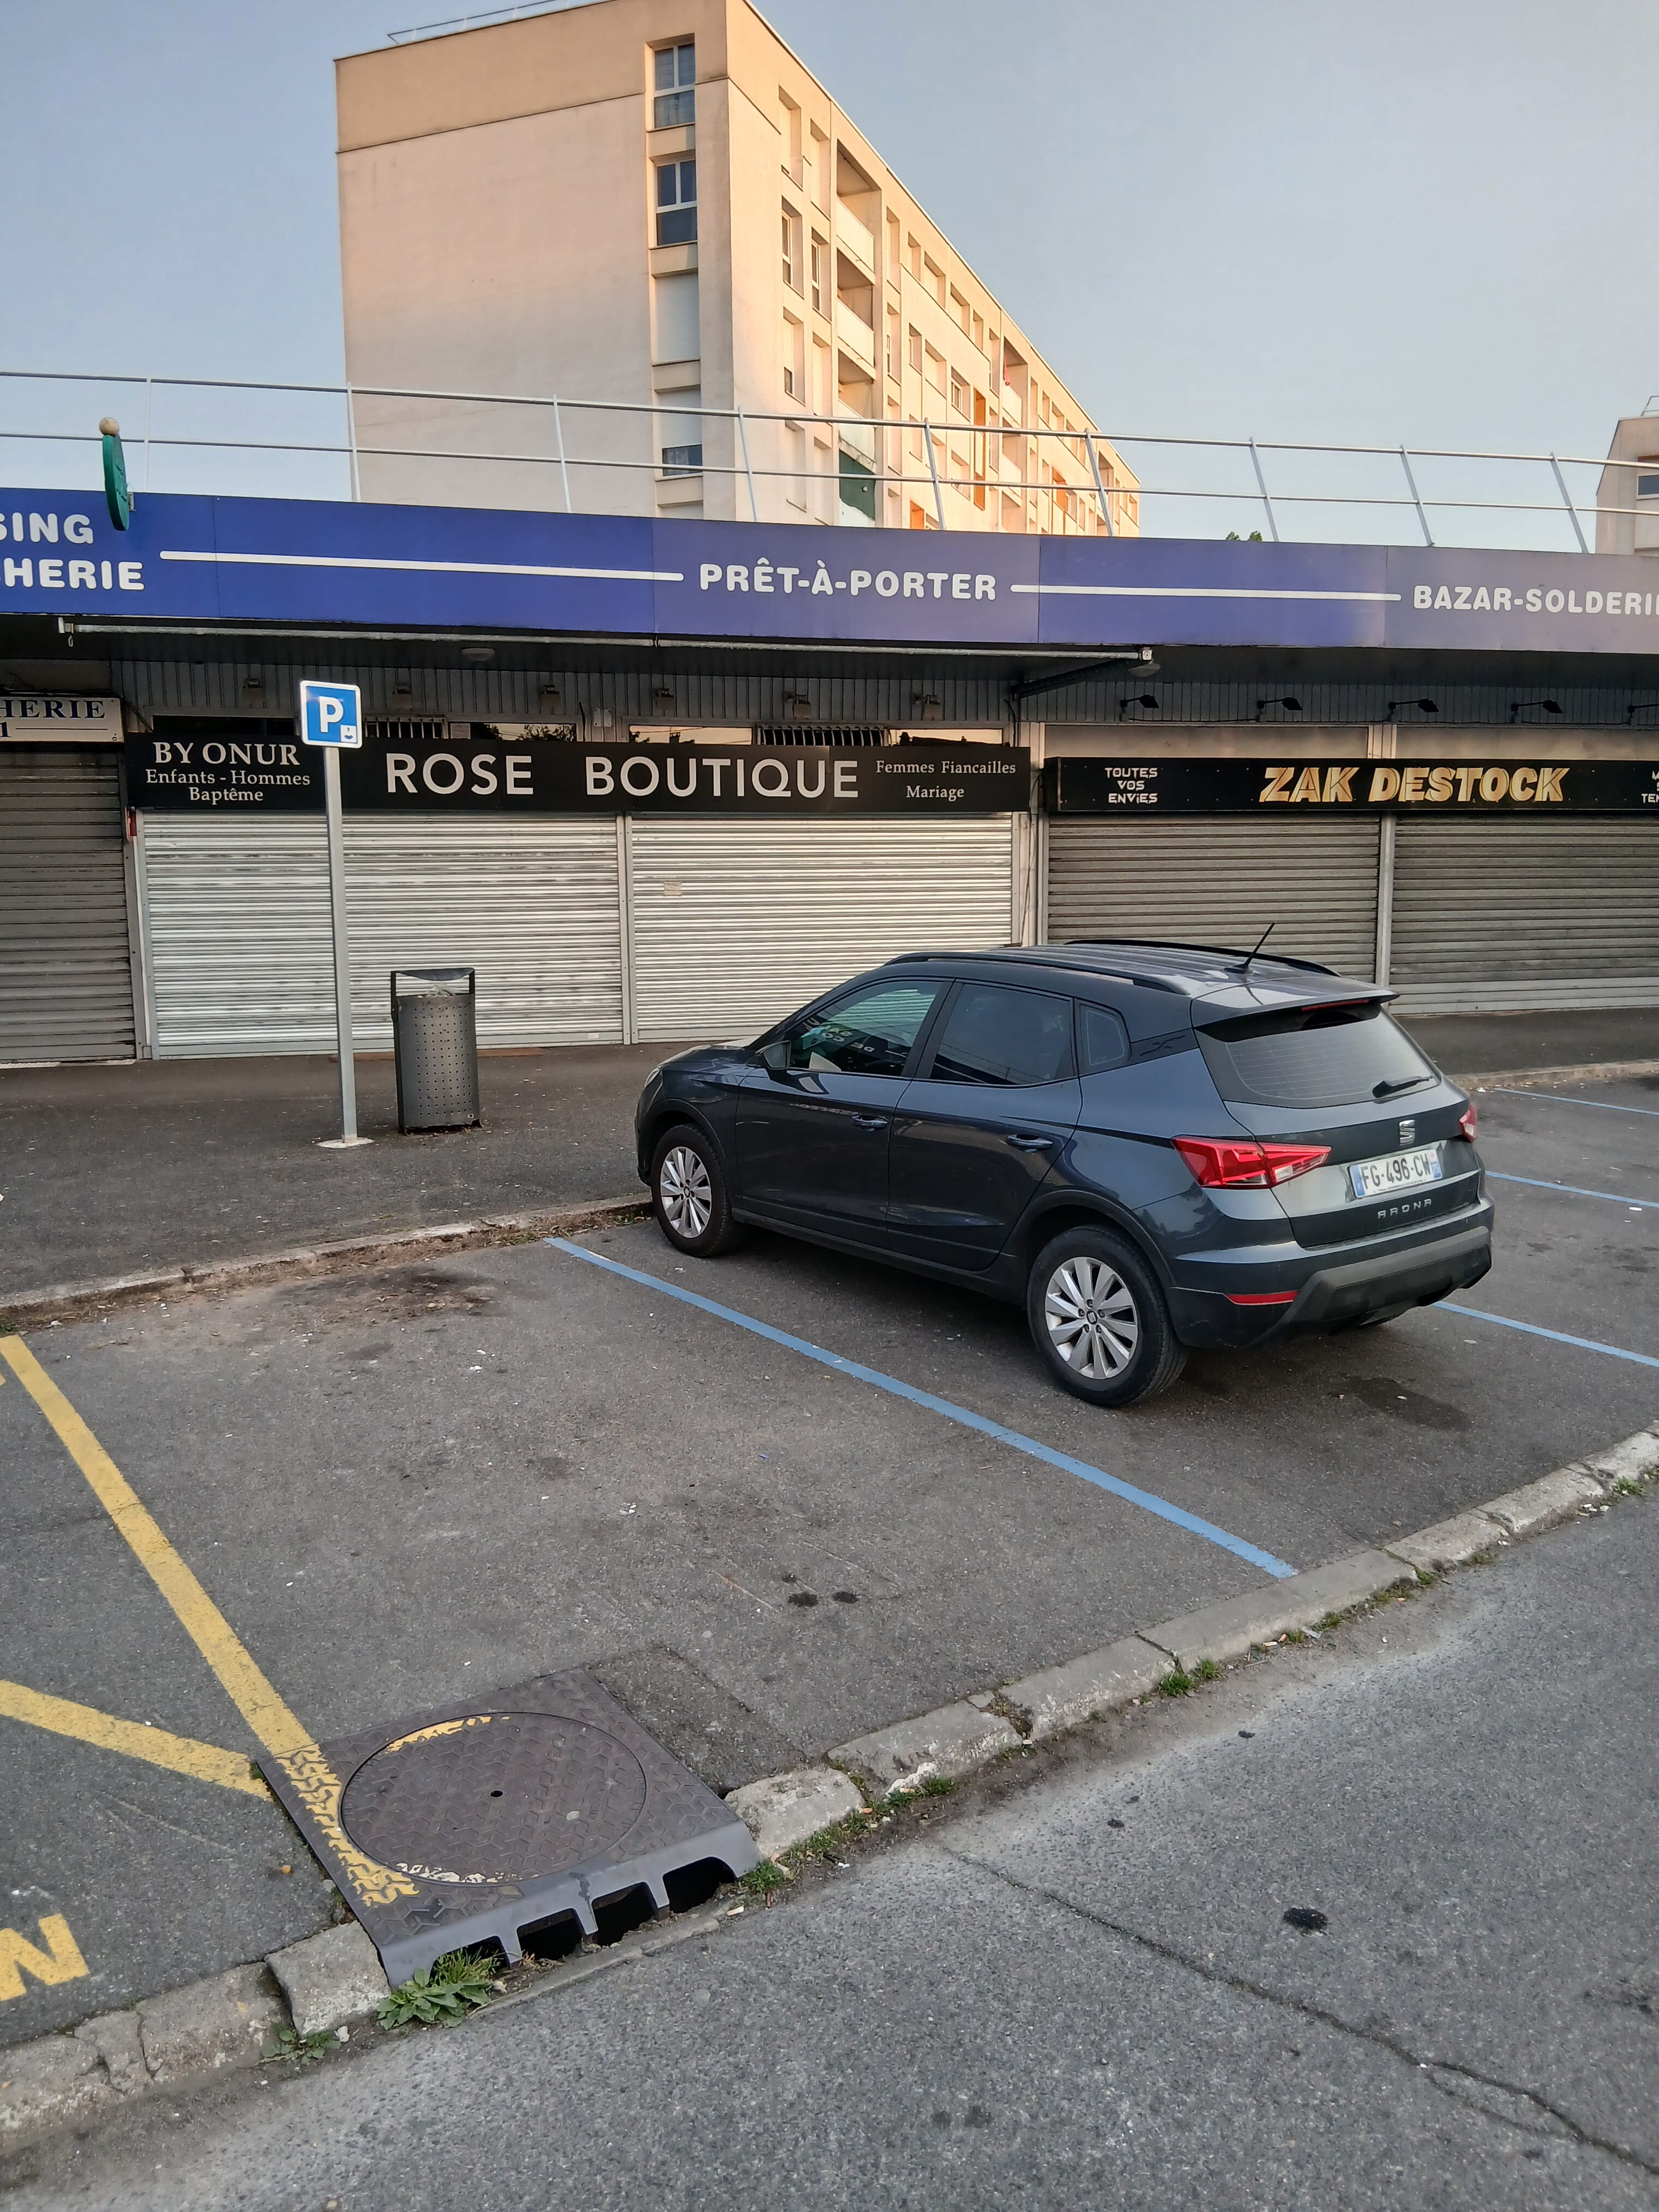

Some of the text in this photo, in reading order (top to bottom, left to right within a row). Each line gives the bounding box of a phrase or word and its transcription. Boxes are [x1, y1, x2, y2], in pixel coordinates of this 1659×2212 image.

[0, 512, 93, 544] ING
[700, 557, 996, 600] PRÊT-À-PORTER
[1414, 585, 1659, 616] BAZAR-SOLDERI
[319, 696, 343, 732] P
[153, 742, 300, 765] BY ONUR
[146, 769, 215, 783] Enfants
[230, 770, 310, 785] Hommes
[386, 753, 858, 798] ROSE BOUTIQUE
[876, 761, 1016, 774] Femmes Fiancailles
[1104, 768, 1158, 779] TOUTES
[906, 786, 964, 802] Mariage
[1117, 780, 1145, 792] VOS
[1259, 767, 1570, 802] ZAK DESTOCK
[189, 787, 263, 805] Baptême
[1377, 1198, 1432, 1219] ARONA
